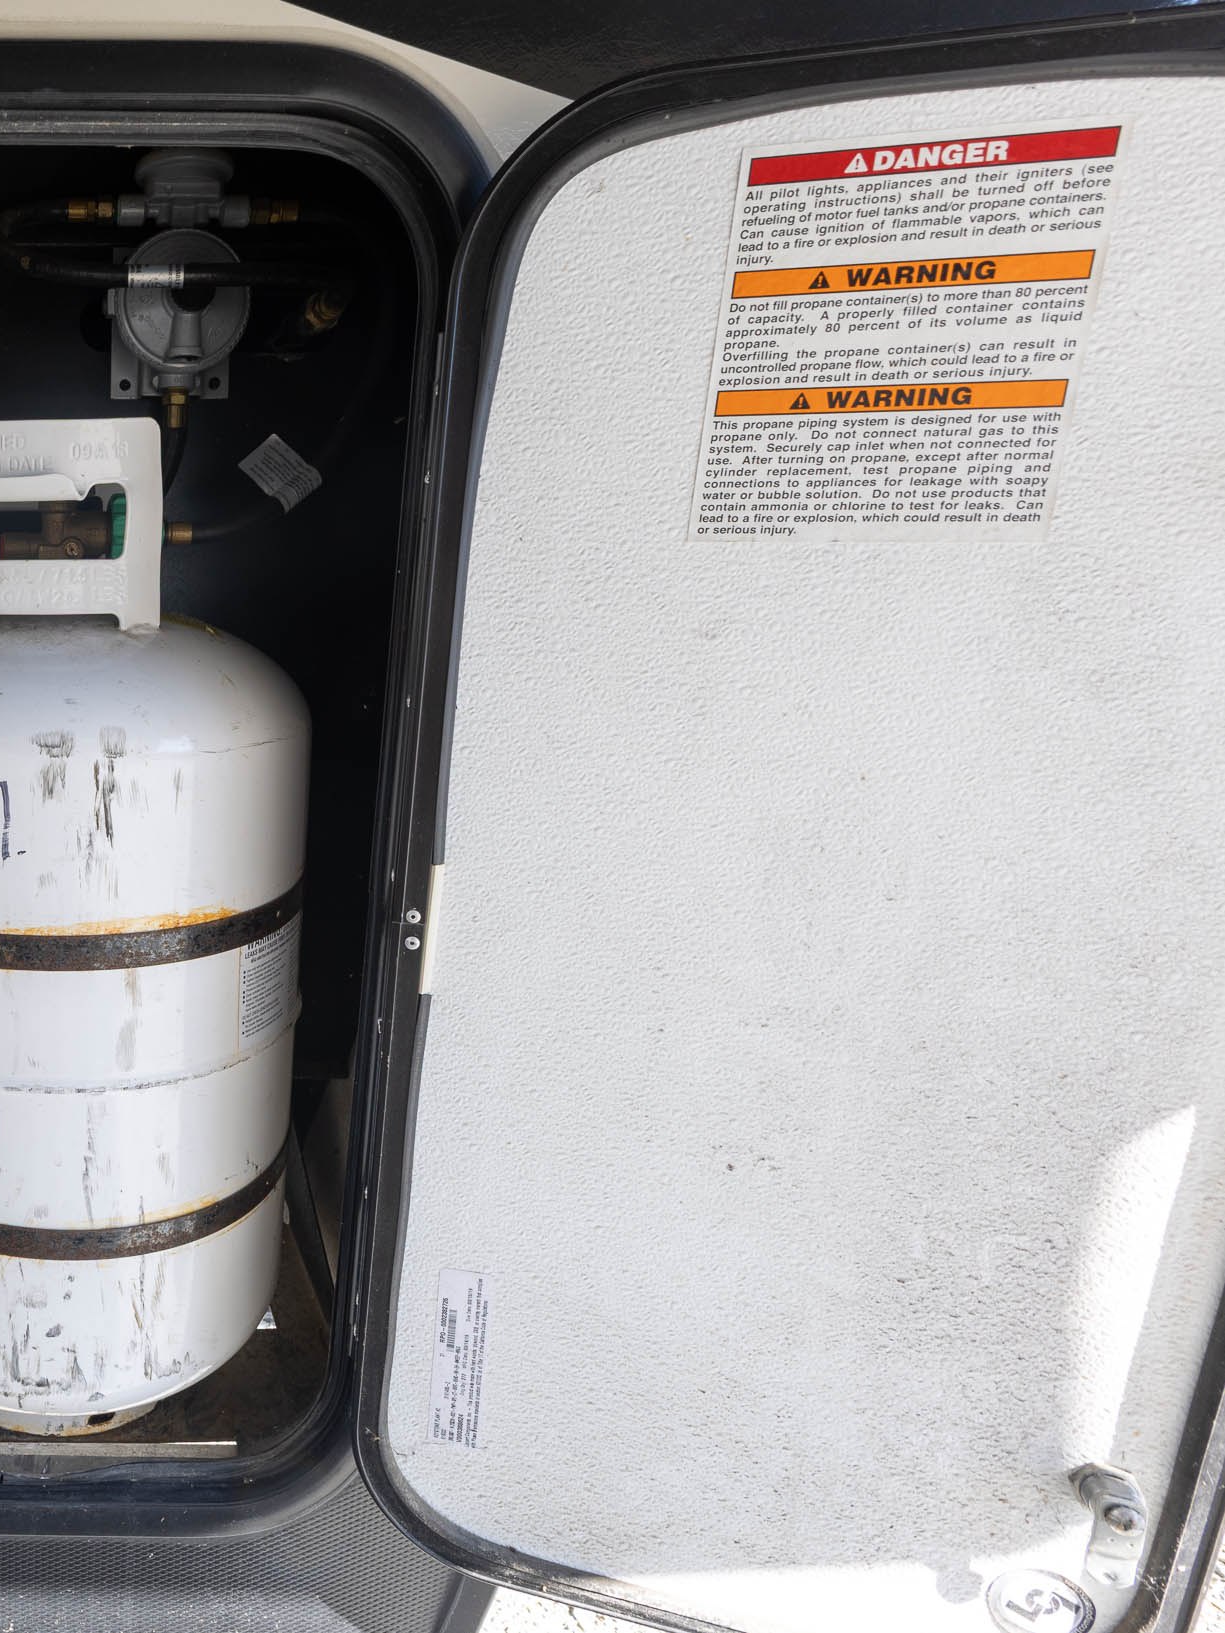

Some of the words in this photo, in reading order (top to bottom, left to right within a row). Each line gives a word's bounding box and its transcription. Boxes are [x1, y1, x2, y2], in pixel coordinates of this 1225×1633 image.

[872, 140, 1010, 171] DANGER
[745, 190, 763, 200] All
[769, 187, 800, 200] pilot
[856, 176, 933, 193] appliances
[940, 173, 967, 185] and
[974, 170, 1008, 182] their
[1015, 165, 1073, 181] igniters
[1081, 162, 1114, 175] (see
[742, 199, 806, 215] operating
[814, 192, 902, 209] instructions)
[909, 189, 943, 200] shall
[951, 187, 970, 197] be
[977, 183, 1025, 195] turned
[1033, 180, 1054, 191] off
[1061, 176, 1112, 189] before
[741, 213, 796, 228] refueling
[798, 212, 812, 222] of
[814, 209, 853, 221] motor
[855, 207, 880, 218] fuel
[882, 204, 919, 216] tanks
[922, 201, 966, 213] and/or
[968, 198, 1026, 212] propane
[1028, 190, 1107, 205] containers.
[739, 228, 764, 239] Can
[770, 227, 809, 236] cause
[814, 221, 865, 236] ignition
[871, 220, 885, 230] of
[891, 214, 963, 228] flammable
[1028, 206, 1071, 219] which
[1077, 206, 1104, 215] can
[735, 253, 774, 266] injury.
[845, 260, 997, 287] WARNING
[728, 303, 747, 312] Do
[749, 301, 769, 311] not
[771, 300, 787, 310] fill
[790, 299, 843, 311] propane
[845, 293, 923, 307] container(s)
[926, 292, 940, 302] to
[943, 292, 978, 301] more
[980, 288, 1012, 299] than
[1014, 287, 1032, 297] 80
[1034, 284, 1089, 298] percent
[727, 315, 740, 324] of
[746, 312, 805, 325] capacity.
[819, 311, 830, 320] A
[836, 307, 894, 321] properly
[902, 305, 937, 316] filled
[945, 301, 1014, 313] container
[1021, 297, 1086, 310] contains
[724, 324, 818, 339] approximately
[824, 323, 841, 332] 80
[847, 320, 900, 333] percent
[906, 319, 922, 328] of
[929, 317, 947, 327] its
[954, 314, 1008, 326] volume
[1015, 315, 1032, 323] as
[1040, 311, 1083, 324] liquid
[721, 350, 789, 363] Overfilling
[795, 349, 817, 358] the
[823, 348, 879, 359] propane
[886, 342, 971, 355] container(s)
[1013, 338, 1055, 349] result
[1063, 337, 1077, 347] in
[723, 340, 780, 351] propane.
[717, 375, 780, 387] explosion
[783, 374, 808, 383] and
[812, 372, 851, 382] result
[854, 372, 867, 380] in
[870, 370, 909, 380] death
[931, 367, 985, 378] serious
[988, 365, 1033, 378] injury.
[824, 386, 973, 408] WARNING
[711, 420, 738, 429] This
[742, 421, 794, 430] propane
[797, 418, 837, 429] piping
[842, 416, 889, 428] system
[894, 416, 906, 424] is
[909, 414, 972, 426] designed
[977, 413, 997, 422] for
[1001, 414, 1027, 422] use
[1031, 411, 1062, 421] with
[709, 434, 762, 443] propane
[767, 431, 798, 442] only.
[810, 430, 829, 439] Do
[834, 429, 857, 438] not
[862, 428, 917, 438] connect
[923, 426, 972, 436] natural
[977, 428, 1004, 437] gas
[1010, 425, 1025, 434] to
[1031, 424, 1060, 434] this
[708, 444, 757, 455] system.
[765, 442, 823, 454] Securely
[826, 444, 851, 452] cap
[855, 441, 884, 450] inlet
[888, 440, 925, 449] when
[929, 439, 953, 448] not
[956, 437, 1032, 448] connected
[1035, 437, 1057, 446] for
[741, 455, 773, 464] After
[777, 454, 824, 465] turning
[914, 451, 961, 463] except
[966, 451, 999, 460] after
[1003, 449, 1054, 459] normal
[8, 454, 53, 472] DATE
[703, 479, 781, 488] connections
[786, 478, 800, 487] to
[805, 477, 877, 488] appliances
[883, 477, 903, 485] for
[909, 476, 962, 487] leakage
[968, 475, 999, 484] with
[1004, 477, 1048, 486] soapy
[701, 491, 736, 499] water
[757, 490, 801, 499] bubble
[804, 489, 862, 498] solution.
[871, 489, 890, 498] Do
[894, 489, 917, 497] not
[950, 488, 1014, 499] products
[1018, 487, 1047, 496] that
[700, 502, 746, 511] contain
[750, 502, 808, 510] ammonia
[831, 501, 886, 510] chlorine
[890, 501, 904, 509] to
[908, 501, 935, 509] test
[939, 500, 959, 509] for
[964, 500, 1005, 509] leaks.
[1015, 499, 1044, 508] Can
